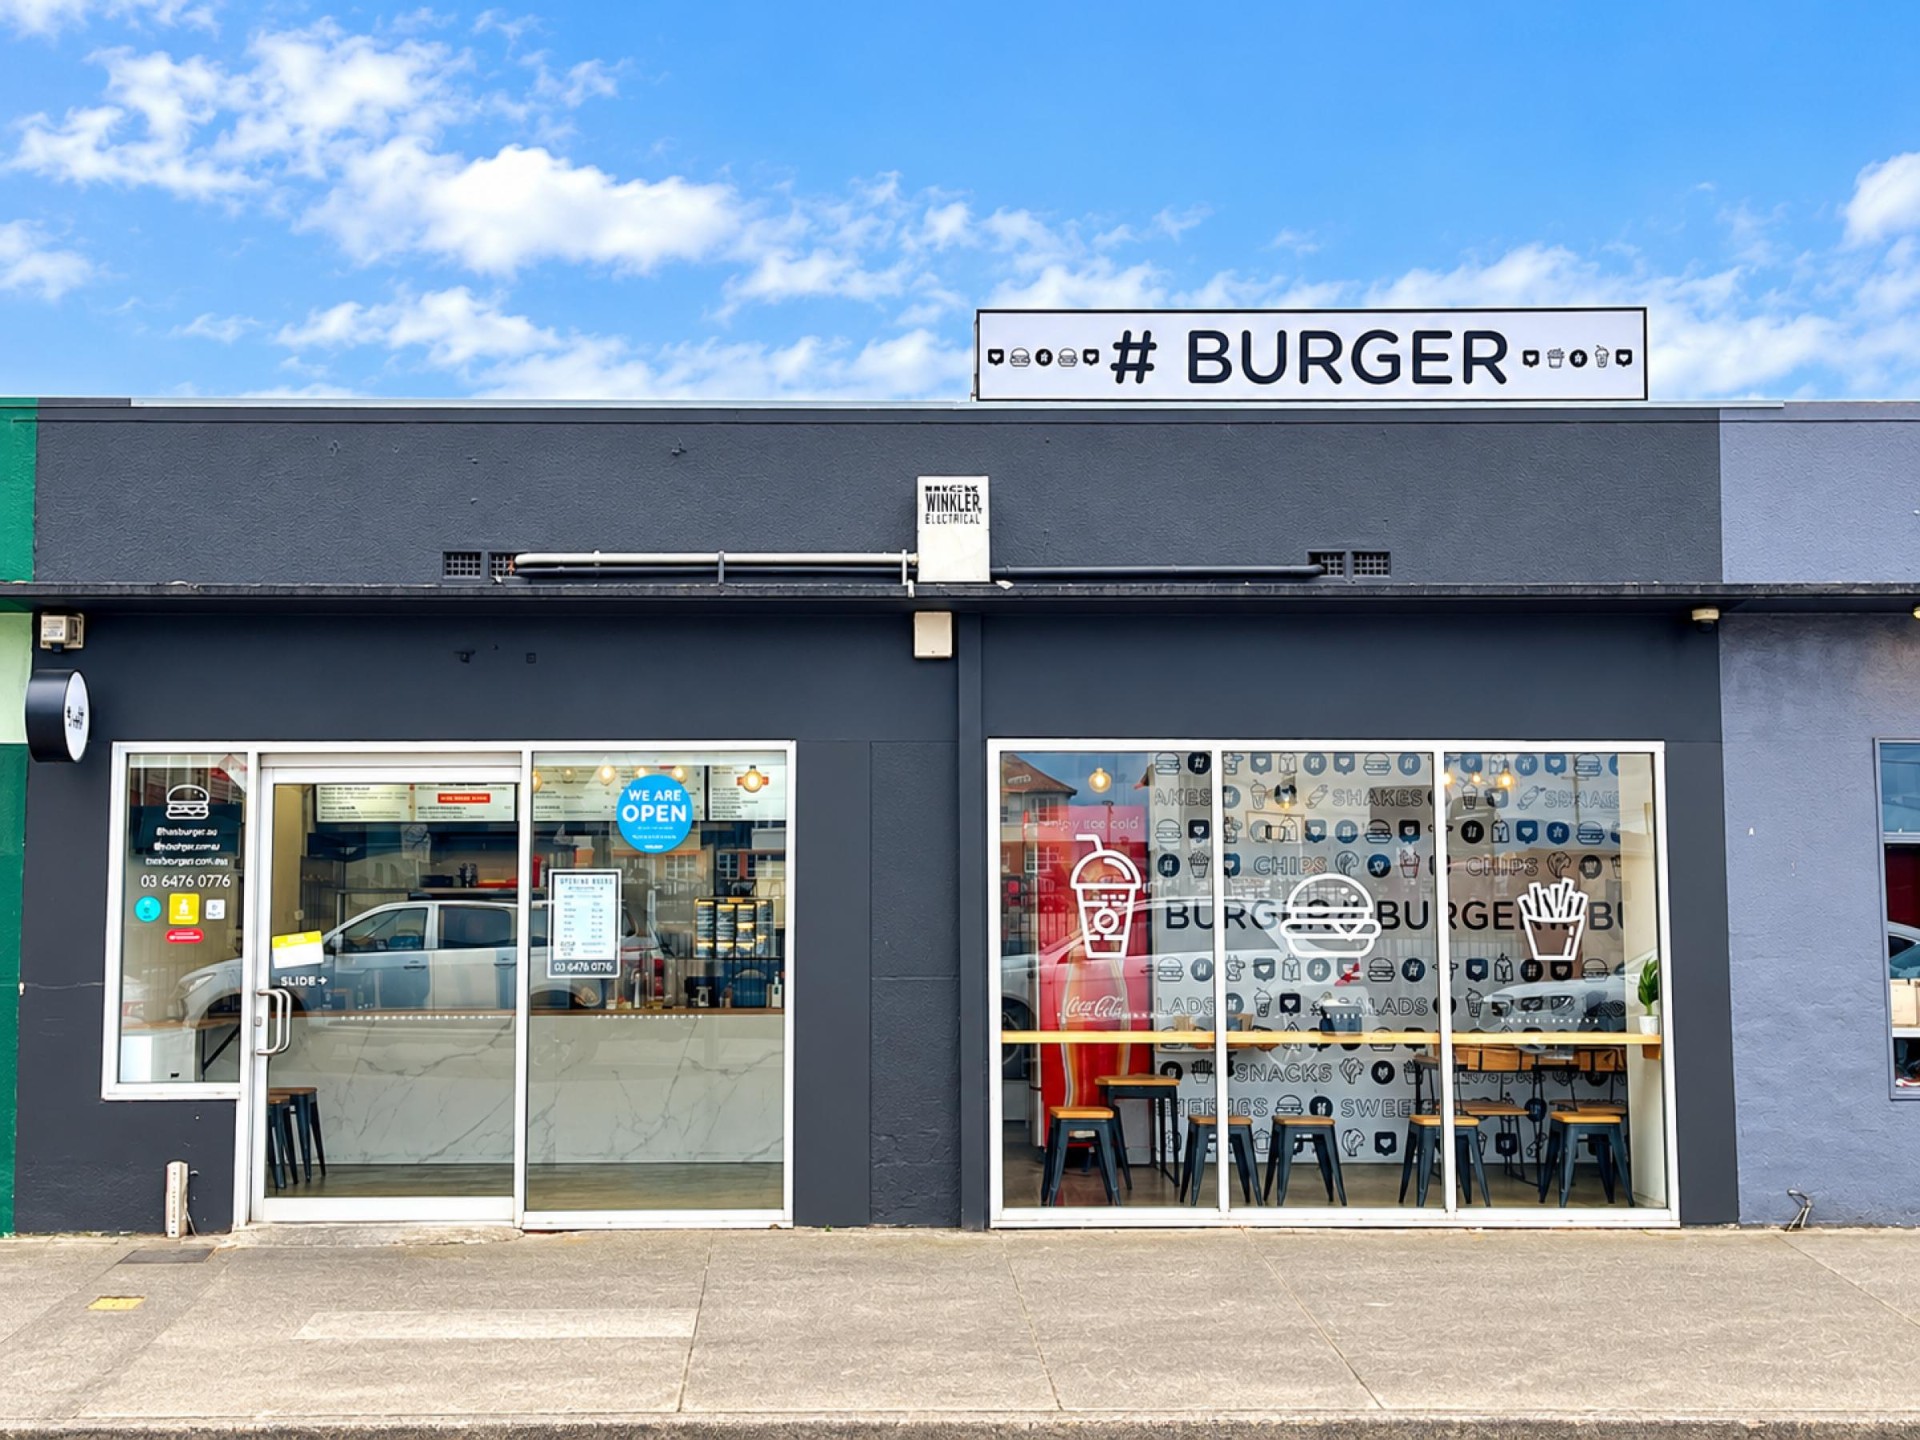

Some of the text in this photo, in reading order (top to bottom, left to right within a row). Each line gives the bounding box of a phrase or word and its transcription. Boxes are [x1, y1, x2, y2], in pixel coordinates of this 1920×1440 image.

[1110, 329, 1508, 384] # BURGER
[926, 493, 981, 513] WINKLER
[925, 513, 980, 524] ELECTRICAL
[628, 790, 682, 801] WE ARE
[1332, 789, 1423, 807] SHAKES
[622, 804, 687, 822] OPEN
[1254, 855, 1327, 876] CHIPS
[1465, 856, 1539, 877] CHIPS
[140, 874, 231, 888] 03 6476 0776
[280, 976, 316, 986] SLIDE
[1234, 1062, 1333, 1083] SNACKS
